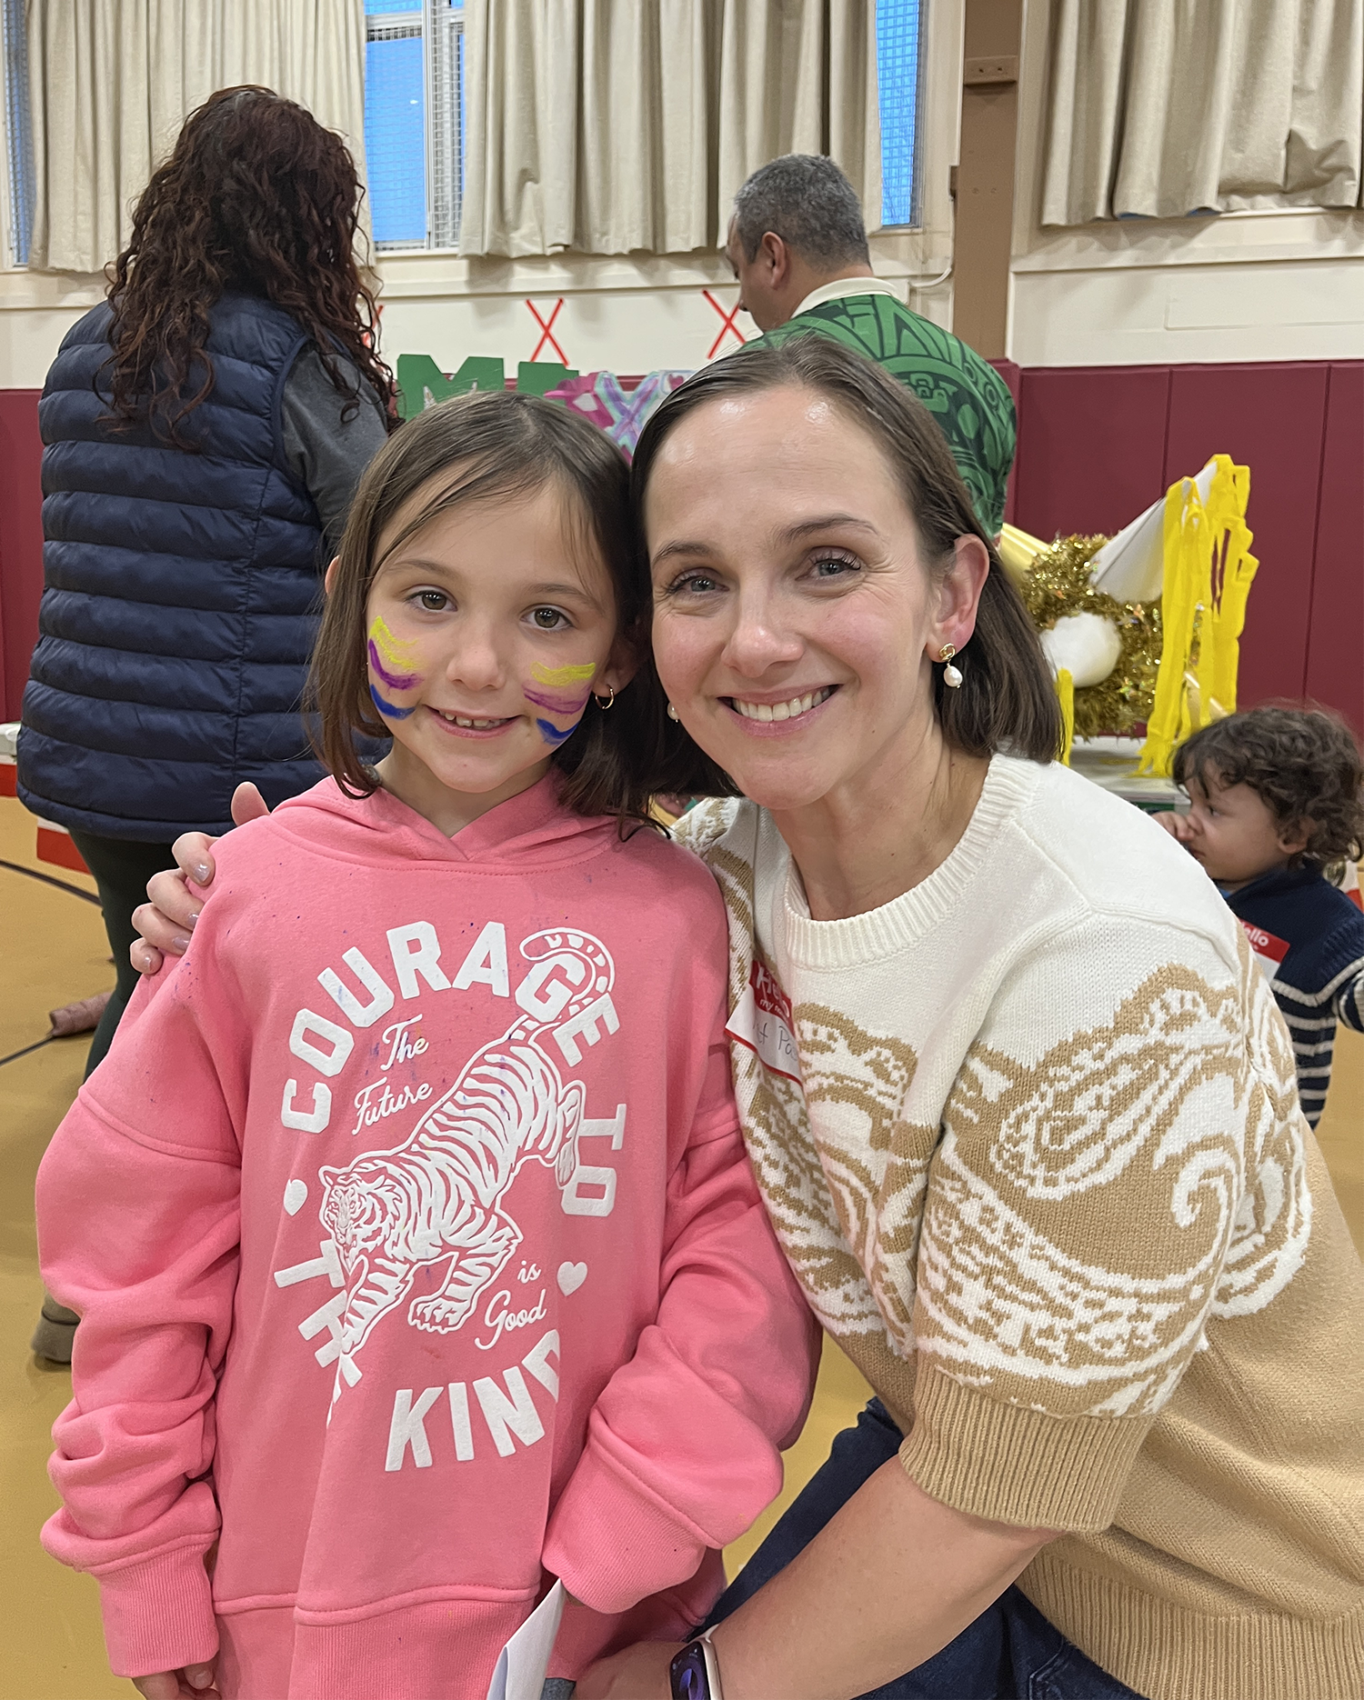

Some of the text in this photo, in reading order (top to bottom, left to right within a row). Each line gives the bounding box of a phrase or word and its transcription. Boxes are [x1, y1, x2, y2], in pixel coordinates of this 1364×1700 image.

[281, 920, 620, 1134] COURAGE
[380, 1014, 429, 1071] The
[351, 1076, 433, 1136] Future
[517, 1260, 542, 1284] is
[274, 1239, 363, 1428] TH
[474, 1288, 547, 1351] Good
